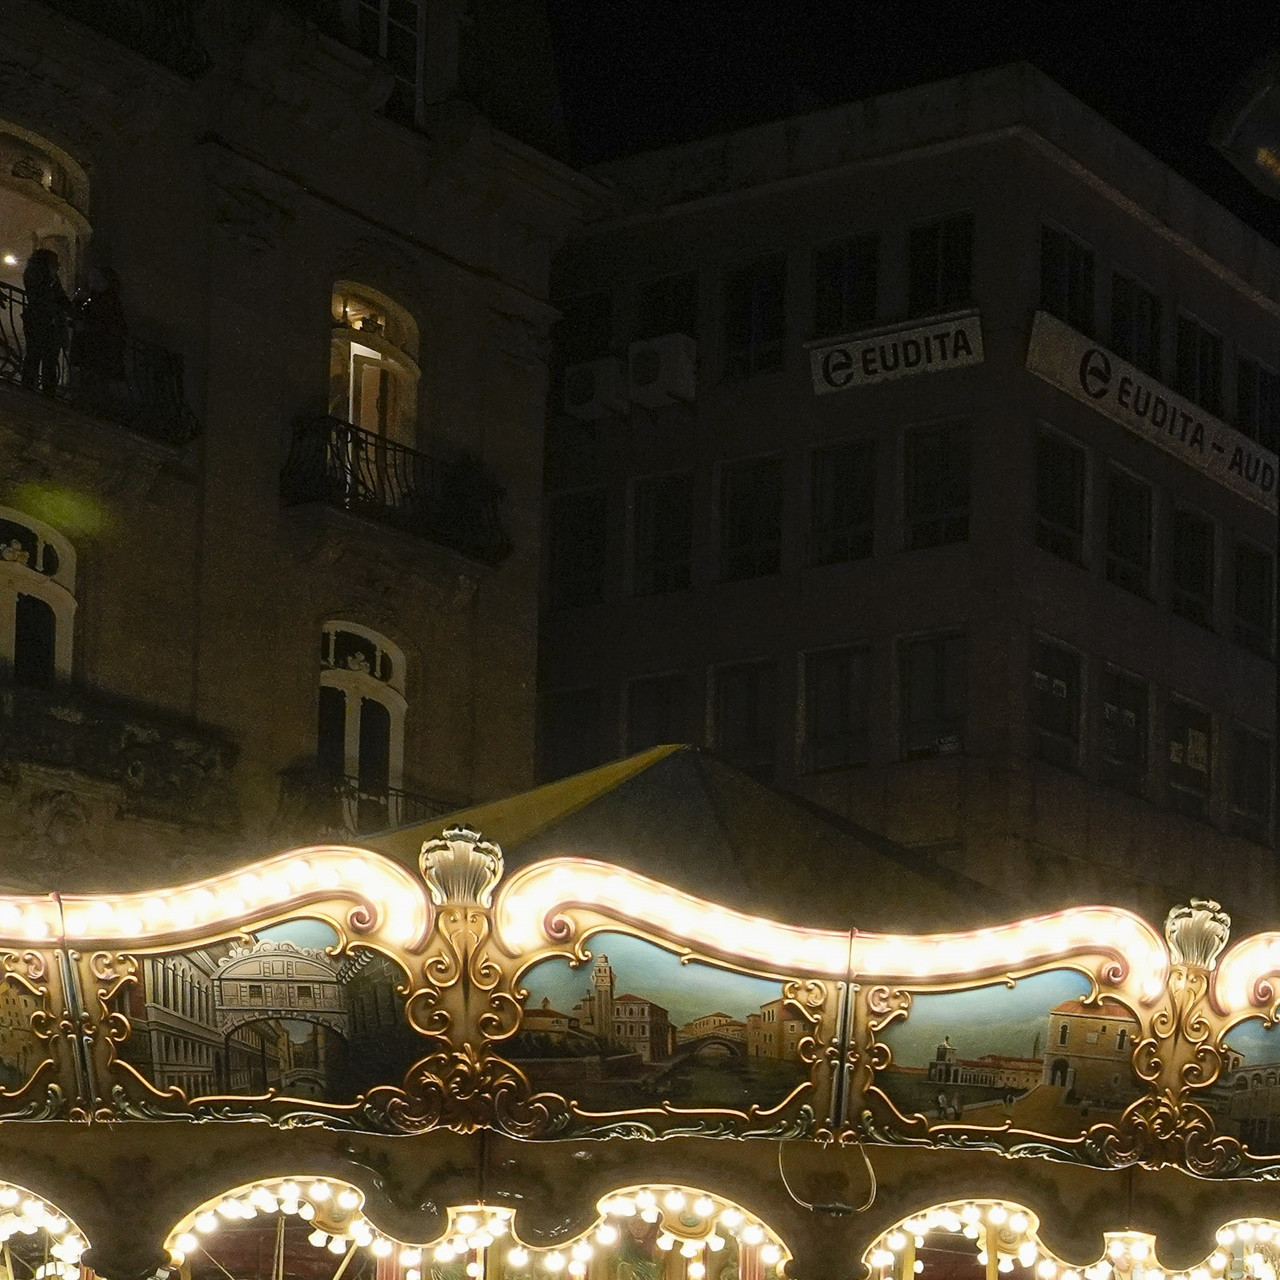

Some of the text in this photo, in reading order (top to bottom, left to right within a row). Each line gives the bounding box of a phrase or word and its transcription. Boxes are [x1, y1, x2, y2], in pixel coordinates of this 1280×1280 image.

[862, 329, 972, 376] EUDITA
[1117, 376, 1207, 455] EUDITA
[1229, 447, 1275, 492] AUD
